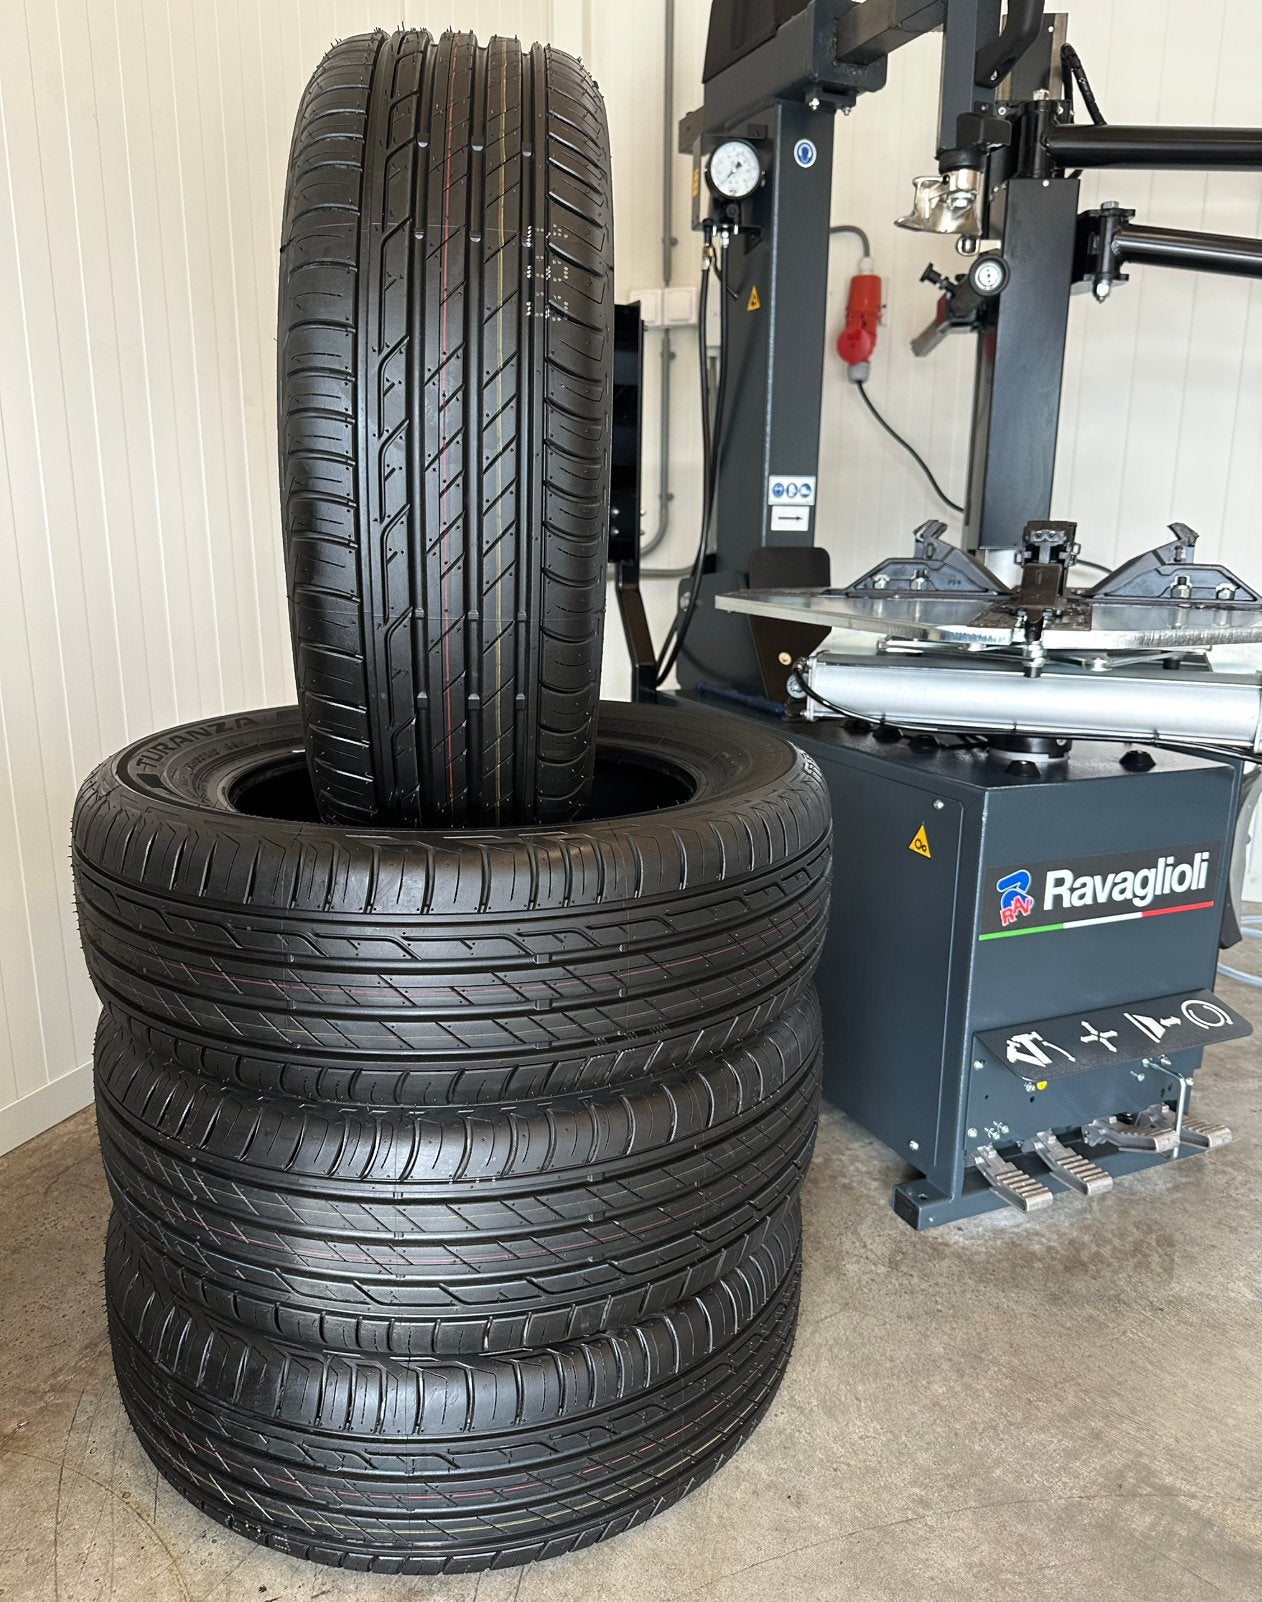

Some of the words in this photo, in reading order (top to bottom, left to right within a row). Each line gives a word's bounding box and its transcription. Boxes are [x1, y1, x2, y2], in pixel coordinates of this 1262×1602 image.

[136, 716, 261, 771] TURANZA
[1043, 851, 1210, 910] Ravaglioli
[1000, 896, 1032, 927] RAV
